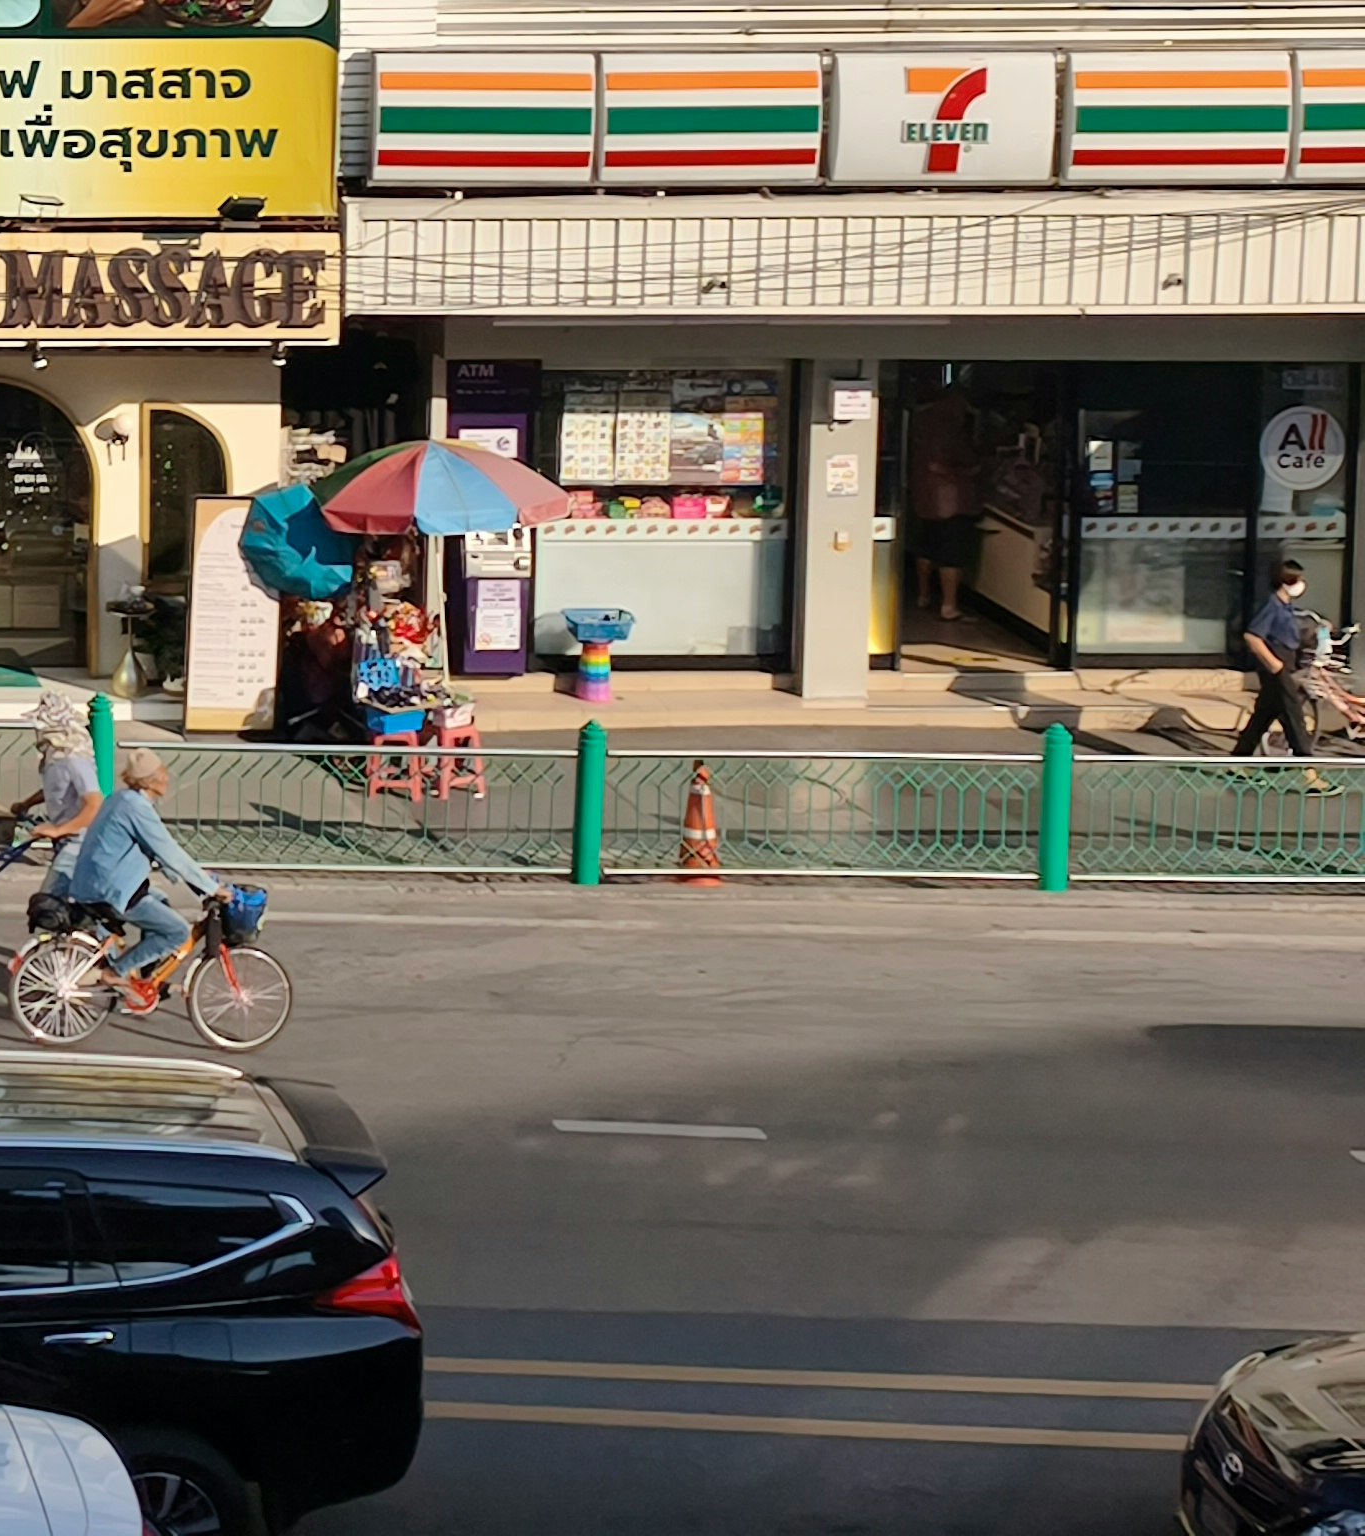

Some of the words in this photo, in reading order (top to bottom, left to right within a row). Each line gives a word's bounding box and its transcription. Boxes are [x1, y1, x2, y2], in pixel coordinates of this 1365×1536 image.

[61, 67, 252, 99] มาสสาจ
[904, 66, 988, 174] 7
[457, 363, 495, 378] ATM
